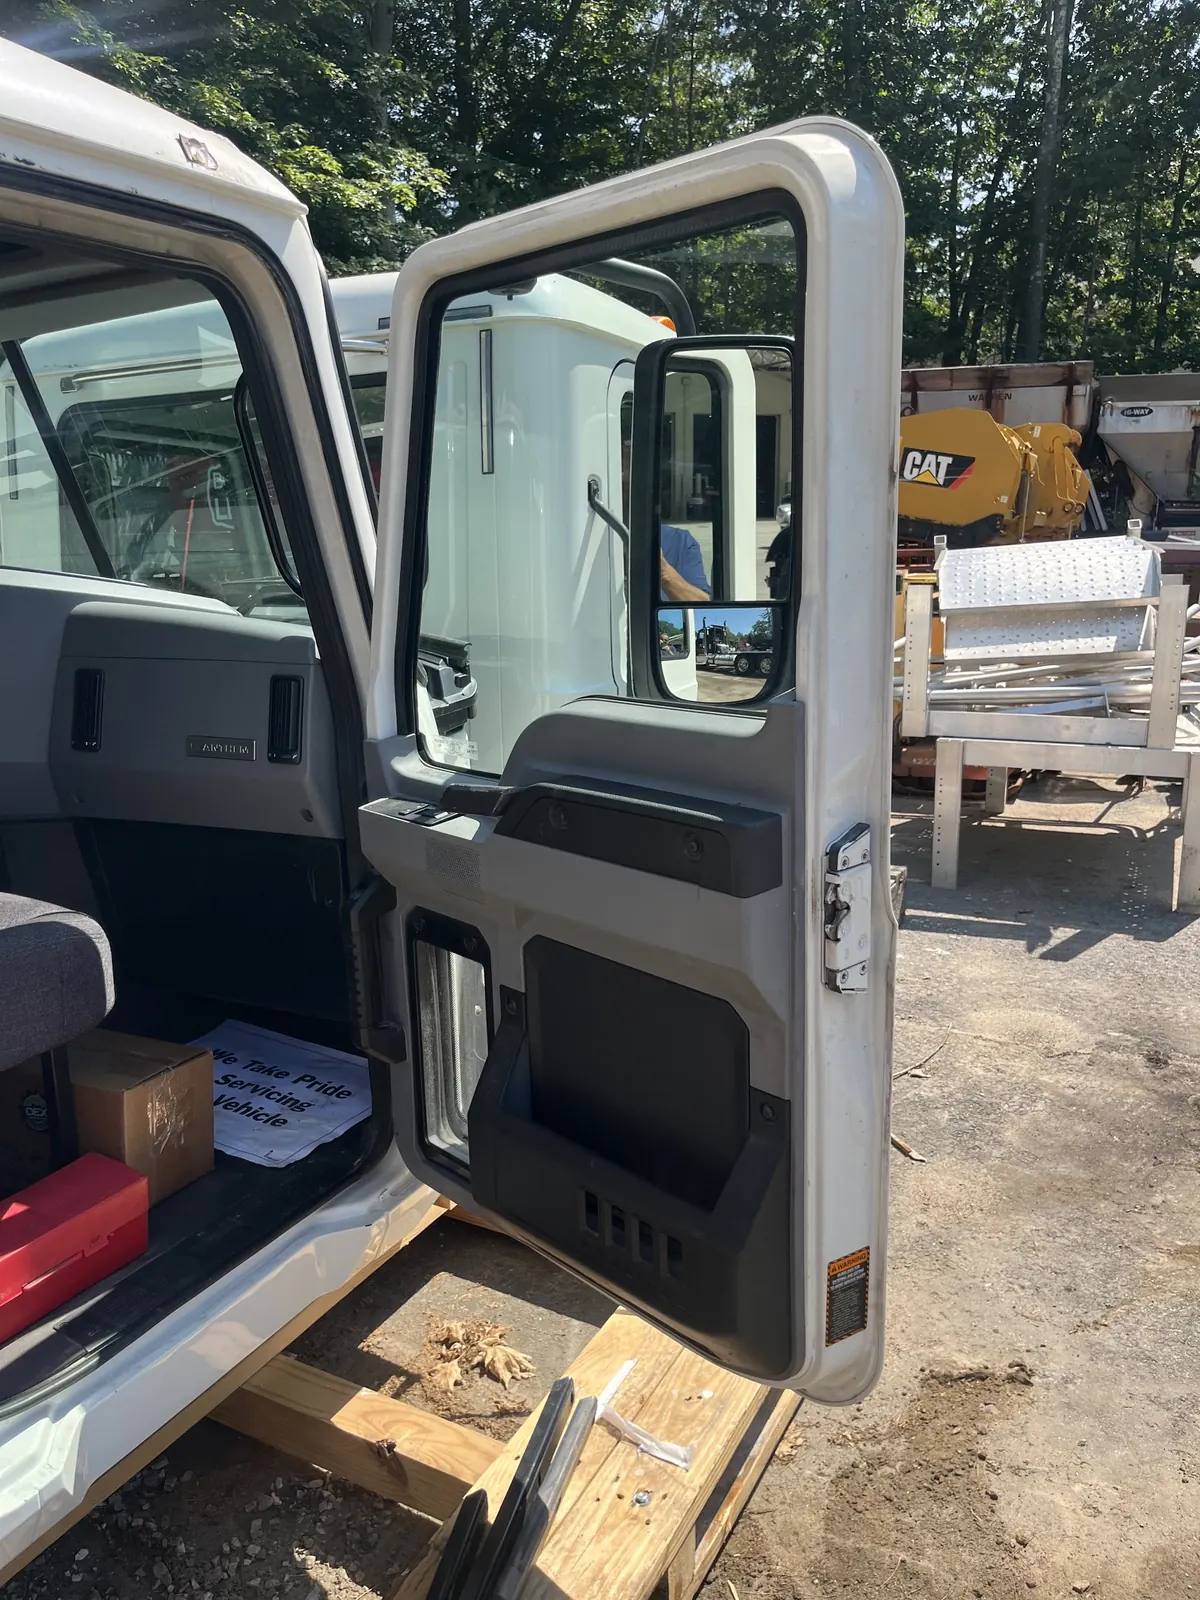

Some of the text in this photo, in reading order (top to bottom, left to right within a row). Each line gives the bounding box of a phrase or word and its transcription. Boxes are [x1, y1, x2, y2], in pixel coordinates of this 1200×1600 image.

[968, 393, 1013, 402] WAEN
[1123, 408, 1150, 416] HI-WAY
[903, 451, 954, 486] CAT
[212, 1048, 353, 1099] We Take Pride
[213, 1093, 289, 1127] Vehicle
[214, 1073, 316, 1113] Servicing
[837, 1252, 867, 1271] WARNING
